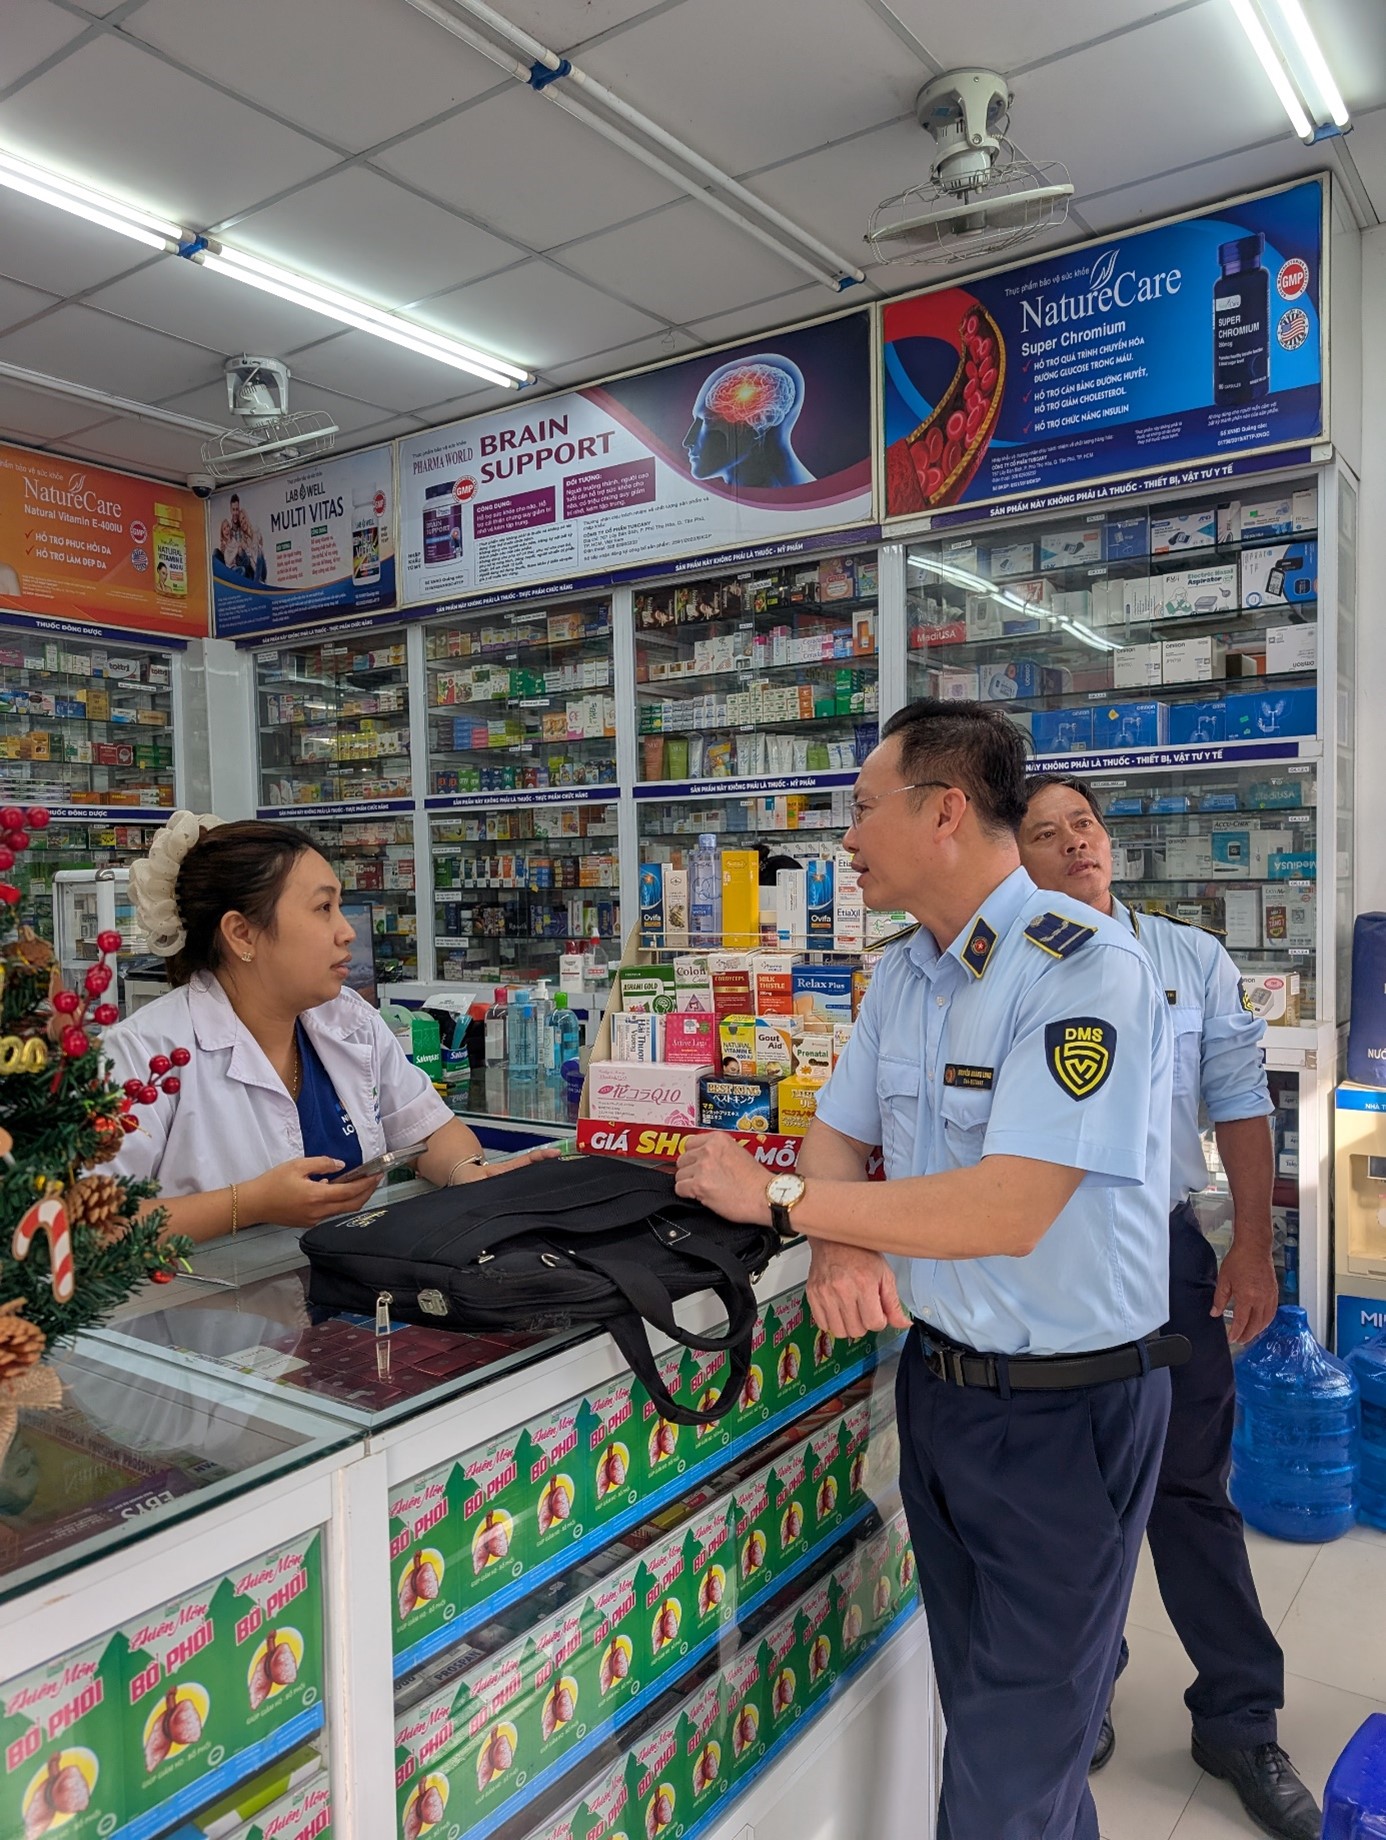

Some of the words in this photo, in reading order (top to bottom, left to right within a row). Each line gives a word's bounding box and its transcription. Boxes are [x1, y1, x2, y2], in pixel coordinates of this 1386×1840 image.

[1282, 272, 1303, 288] GMP
[1020, 269, 1181, 333] NatureCare
[1218, 315, 1240, 326] SUPER
[1218, 322, 1260, 339] CHROMIUM
[1022, 337, 1057, 356] Super
[1061, 320, 1126, 346] Chromium
[1034, 359, 1044, 371] HỖ
[1046, 356, 1060, 368] TRỢ
[1061, 353, 1076, 364] QUÁ
[1077, 348, 1098, 360] TRÌNH
[1128, 336, 1144, 347] HÓA
[1034, 372, 1058, 383] ĐƯỜNG
[1060, 363, 1089, 377] GLUCOSE
[1091, 359, 1114, 369] TRONG
[1115, 353, 1134, 363] MÁU.
[1034, 390, 1045, 401] HỖ
[1046, 387, 1060, 398] TRỢ
[1061, 383, 1075, 394] CÂN
[1096, 372, 1122, 387] ĐƯỜNG
[1034, 404, 1045, 414] HỖ
[1046, 400, 1060, 411] TRỢ
[1035, 421, 1045, 432] HỖ
[1046, 418, 1060, 429] TRỢ
[1061, 414, 1080, 425] CHỨC
[1102, 404, 1129, 417] INSULIN
[480, 414, 568, 457] BRAIN
[413, 455, 445, 475] PHARMA
[443, 447, 473, 469] WORLD
[480, 431, 615, 483] SUPPORT
[23, 476, 122, 518] NatureCare
[285, 490, 298, 503] LAB
[306, 482, 325, 497] WELL
[456, 486, 473, 496] GMP
[990, 505, 1005, 517] SẢN
[1006, 501, 1029, 514] PHẨM
[1030, 499, 1046, 510] NÀY
[1047, 494, 1075, 507] KHÔNG
[1076, 491, 1096, 504] PHẢI
[1097, 488, 1108, 499] LÀ
[1109, 481, 1137, 498] THUỐC
[1144, 474, 1167, 490] THIẾT
[1168, 476, 1180, 487] BỊ,
[1181, 470, 1199, 484] VẬT
[1201, 469, 1213, 481] TƯ
[1214, 469, 1220, 478] Y
[1221, 462, 1234, 477] TẾ
[24, 505, 56, 519] Natural
[58, 511, 89, 526] Vitamin
[270, 506, 306, 533] MULTI
[309, 497, 344, 523] VITAS
[101, 546, 111, 556] DA
[675, 563, 686, 572] SẢN
[687, 561, 701, 570] PHẨM
[713, 555, 732, 565] KHÔNG
[733, 553, 745, 561] PHẢI
[746, 550, 754, 558] LÀ
[754, 548, 772, 558] THUỐC
[777, 545, 785, 554] MỸ
[786, 543, 803, 552] PHẨM
[97, 561, 106, 570] DA
[1187, 572, 1213, 580] Electric
[1214, 568, 1234, 578] Nasal
[1188, 577, 1222, 586] Aspirator
[36, 619, 60, 630] THUỐC
[61, 622, 82, 633] ĐÔNG
[83, 626, 102, 636] DƯỢC
[917, 629, 957, 642] MediUSA
[1042, 761, 1070, 770] KHÔNG
[1071, 759, 1090, 769] PHẢI
[1091, 758, 1102, 767] LÀ
[1103, 754, 1130, 766] THUỐC
[1136, 752, 1160, 763] THIẾT
[1161, 754, 1171, 765] BỊ,
[1172, 752, 1191, 763] VẬT
[1191, 751, 1204, 760] TƯ
[1212, 749, 1223, 759] TẾ
[691, 785, 701, 793] SẢN
[701, 785, 716, 793] PHẨM
[728, 782, 746, 791] KHÔNG
[747, 781, 759, 789] PHẢI
[760, 780, 767, 788] LÀ
[768, 779, 786, 788] THUỐC
[790, 778, 799, 786] MỸ
[644, 914, 661, 922] Ovifa
[676, 967, 706, 975] Colon
[797, 978, 827, 989] Relax
[758, 1033, 779, 1042] Gout
[1065, 1028, 1104, 1042] DMS
[416, 1054, 439, 1063] Salonpas
[797, 1049, 828, 1058] Prenatal
[707, 1083, 732, 1095] BEST
[712, 1094, 755, 1105] ベストキング
[590, 1130, 629, 1152] GIÁ
[754, 1139, 798, 1167] MỖ
[590, 1395, 612, 1415] Thiên
[611, 1387, 631, 1405] Môn
[590, 1422, 606, 1451] BỔ
[607, 1400, 633, 1437] PHỔI
[464, 1454, 494, 1480] Thiên
[493, 1447, 515, 1469] Môn
[464, 1489, 484, 1520] BỔ
[486, 1460, 517, 1501] PHỔI
[233, 1572, 275, 1597] Thiên
[271, 1553, 304, 1580] Môn
[236, 1599, 263, 1647] BỔ
[266, 1567, 308, 1622] PHỔI
[128, 1622, 174, 1654] Thiên
[170, 1603, 210, 1634] Môn
[130, 1653, 161, 1706] BỔ
[165, 1618, 214, 1678] PHỔI
[434, 1650, 482, 1681] PROSPAN
